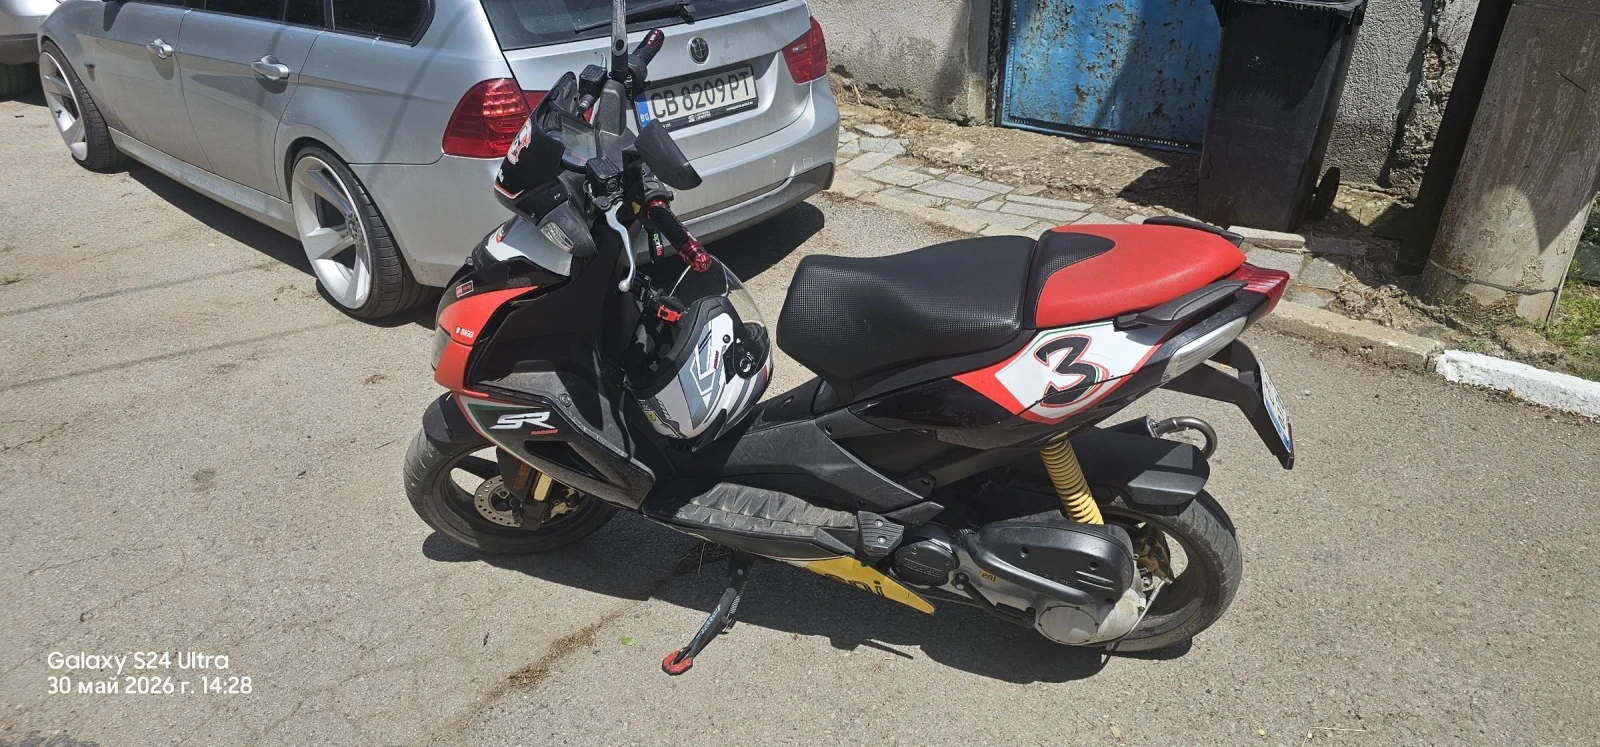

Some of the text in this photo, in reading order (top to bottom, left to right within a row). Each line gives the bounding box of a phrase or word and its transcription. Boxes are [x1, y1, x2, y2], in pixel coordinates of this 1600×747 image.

[650, 70, 750, 119] CB 8209 PT
[640, 112, 650, 122] BG
[1033, 334, 1108, 408] 3
[489, 411, 556, 429] SR
